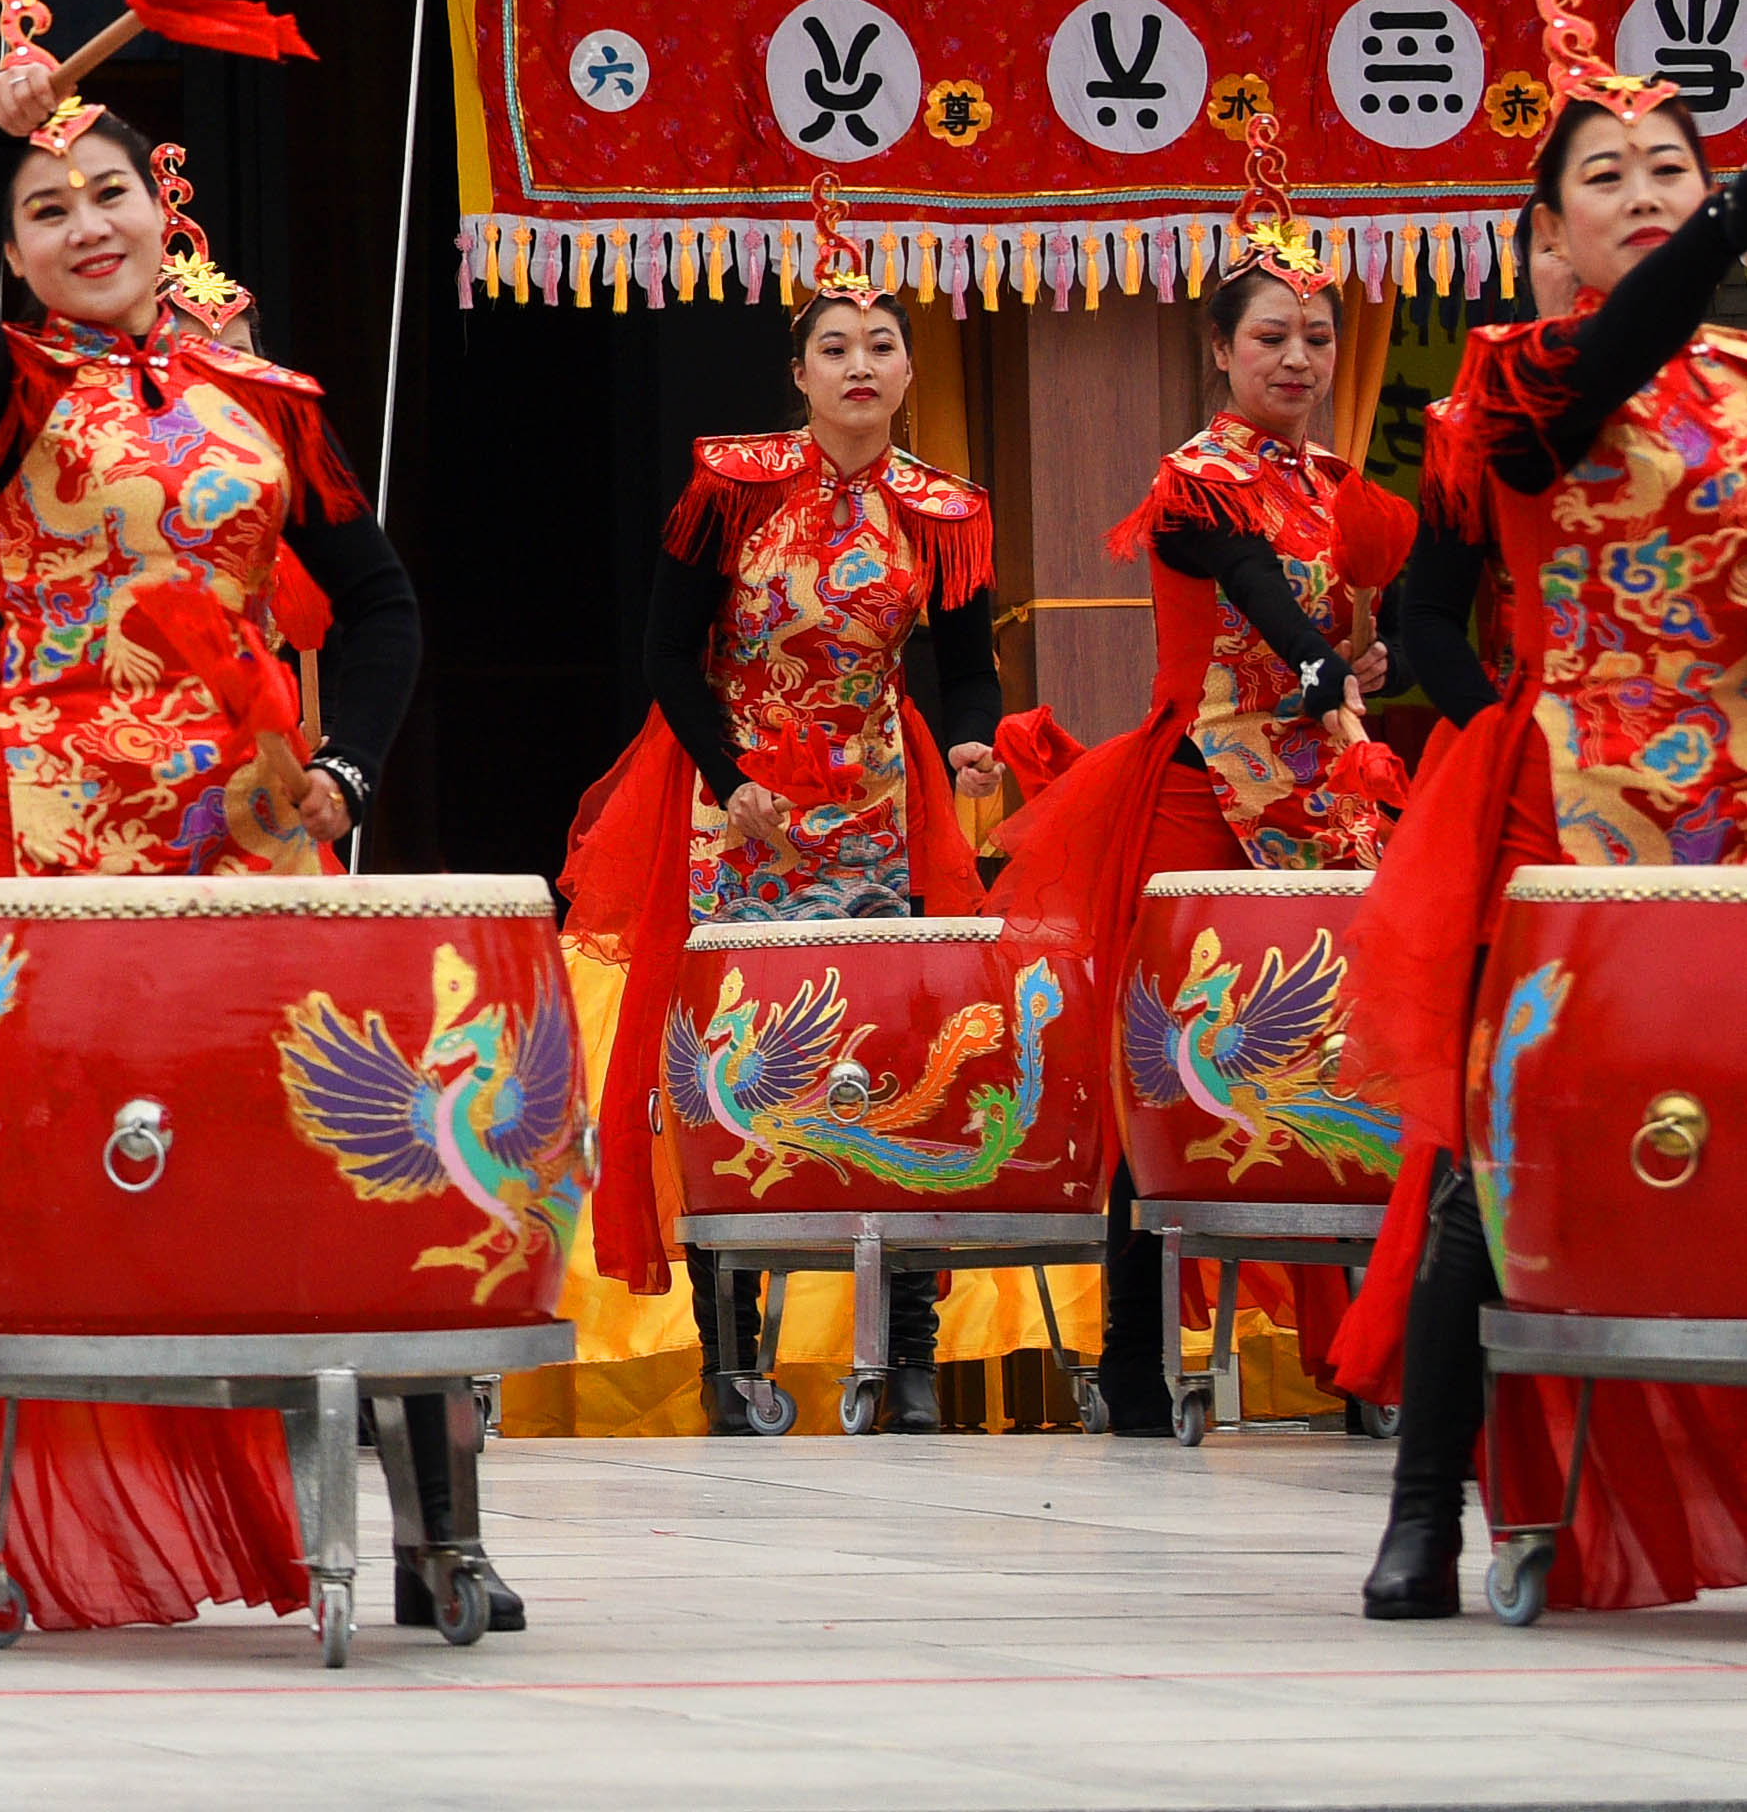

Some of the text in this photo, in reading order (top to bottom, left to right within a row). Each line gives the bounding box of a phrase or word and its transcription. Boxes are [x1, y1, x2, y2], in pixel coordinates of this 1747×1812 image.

[587, 45, 635, 96] 六
[937, 91, 981, 136] 尊
[1500, 84, 1540, 126] 赤
